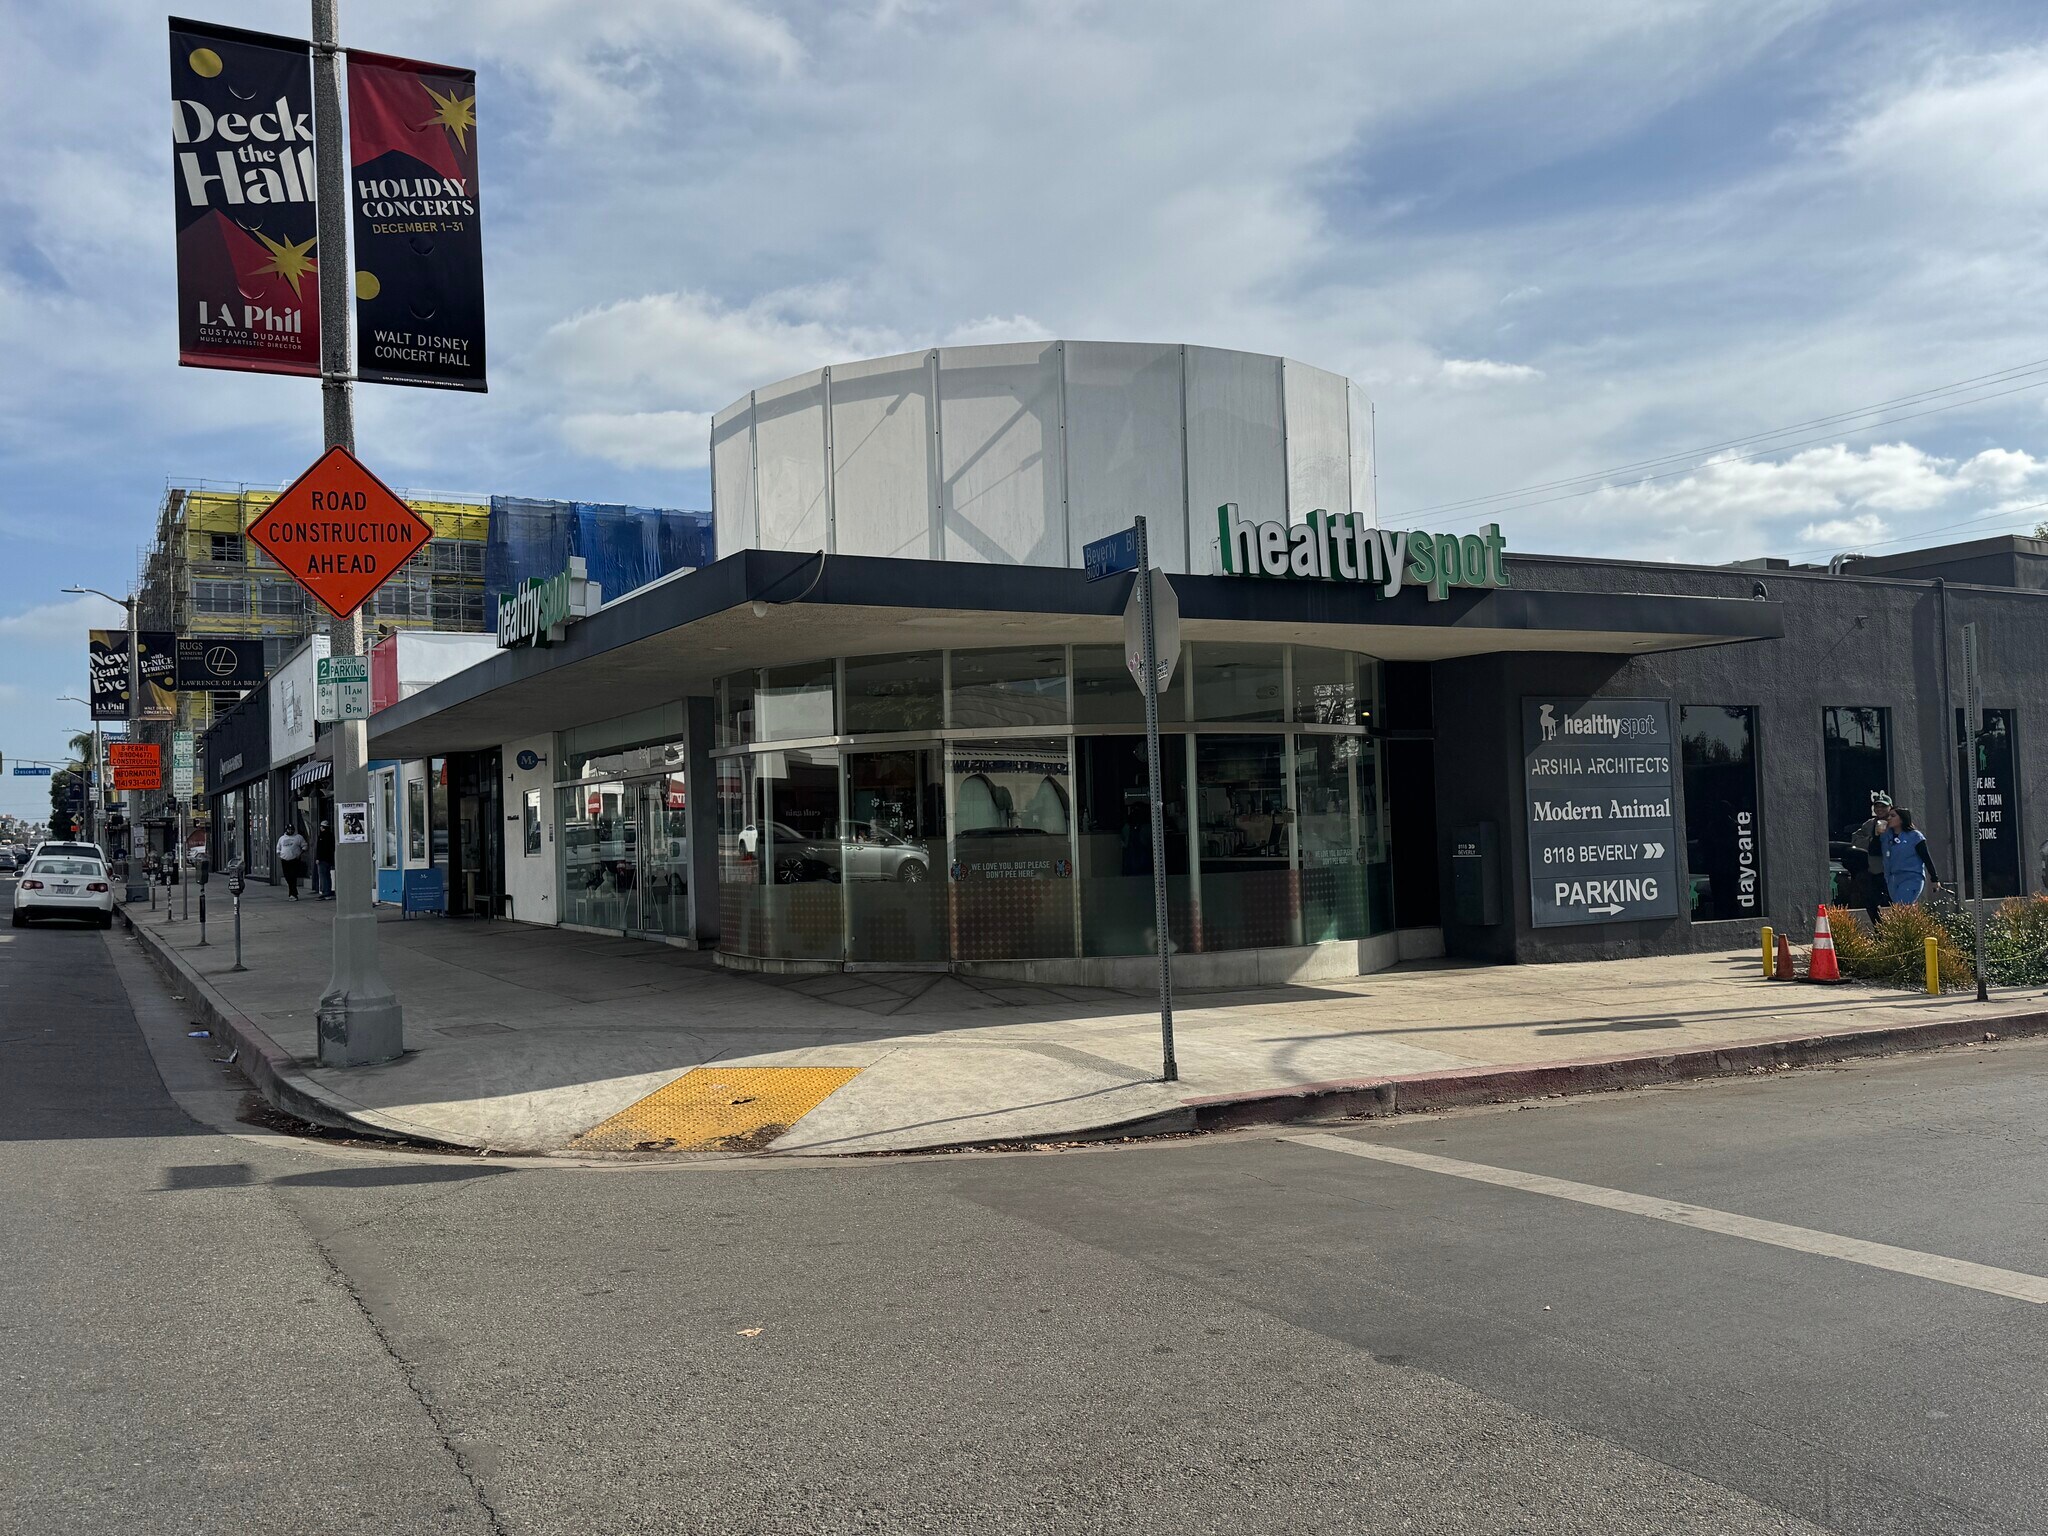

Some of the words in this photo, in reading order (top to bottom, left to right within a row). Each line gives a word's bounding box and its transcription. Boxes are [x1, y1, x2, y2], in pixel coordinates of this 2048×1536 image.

[172, 96, 314, 144] Deck
[238, 144, 276, 163] the
[179, 146, 316, 206] Hall
[358, 178, 467, 199] HOLIDAY
[362, 200, 475, 218] CONCERTS
[372, 222, 438, 234] DECEMBER
[199, 301, 236, 328] LA
[244, 305, 302, 334] Phil
[199, 322, 248, 339] GUSTAVO
[253, 332, 302, 344] DUDAMEL
[374, 330, 412, 345] WALT
[417, 334, 469, 351] DISNEY
[200, 336, 223, 344] MUSIC
[267, 342, 302, 350] DIRECTOR
[374, 345, 436, 362] CONCERT
[439, 352, 471, 367] HALL
[311, 491, 367, 511] ROAD
[268, 522, 413, 543] CONSTRUCTION
[1086, 540, 1118, 565] Beverly
[1218, 503, 1510, 601] healthyspot
[306, 554, 377, 574] AHEAD
[179, 642, 203, 651] RUGS
[90, 652, 129, 667] New
[140, 657, 173, 668] D-NICE
[320, 661, 327, 676] 2
[90, 663, 129, 678] Year's
[331, 665, 366, 677] PARKING
[93, 678, 126, 694] Eve
[108, 702, 125, 710] Phil
[1563, 714, 1658, 739] healthyspot
[1531, 759, 1583, 775] ARSHIA
[1587, 757, 1669, 774] ARCHITECTS
[1984, 777, 1996, 789] ARE
[1987, 794, 2002, 806] THAN
[1533, 800, 1603, 822] Modern
[1609, 798, 1671, 819] Animal
[1985, 811, 1990, 823] A
[1990, 811, 2002, 823] PET
[1979, 828, 1997, 840] STORE
[1543, 846, 1575, 864] 8118
[1579, 844, 1639, 862] BEVERLY
[1737, 811, 1754, 909] daycare
[971, 863, 982, 871] WE
[983, 863, 998, 871] LOVE
[1028, 861, 1050, 869] PLEASE
[986, 871, 1004, 879] DON'T
[1005, 870, 1018, 878] PEE
[1555, 878, 1659, 906] PARKING
